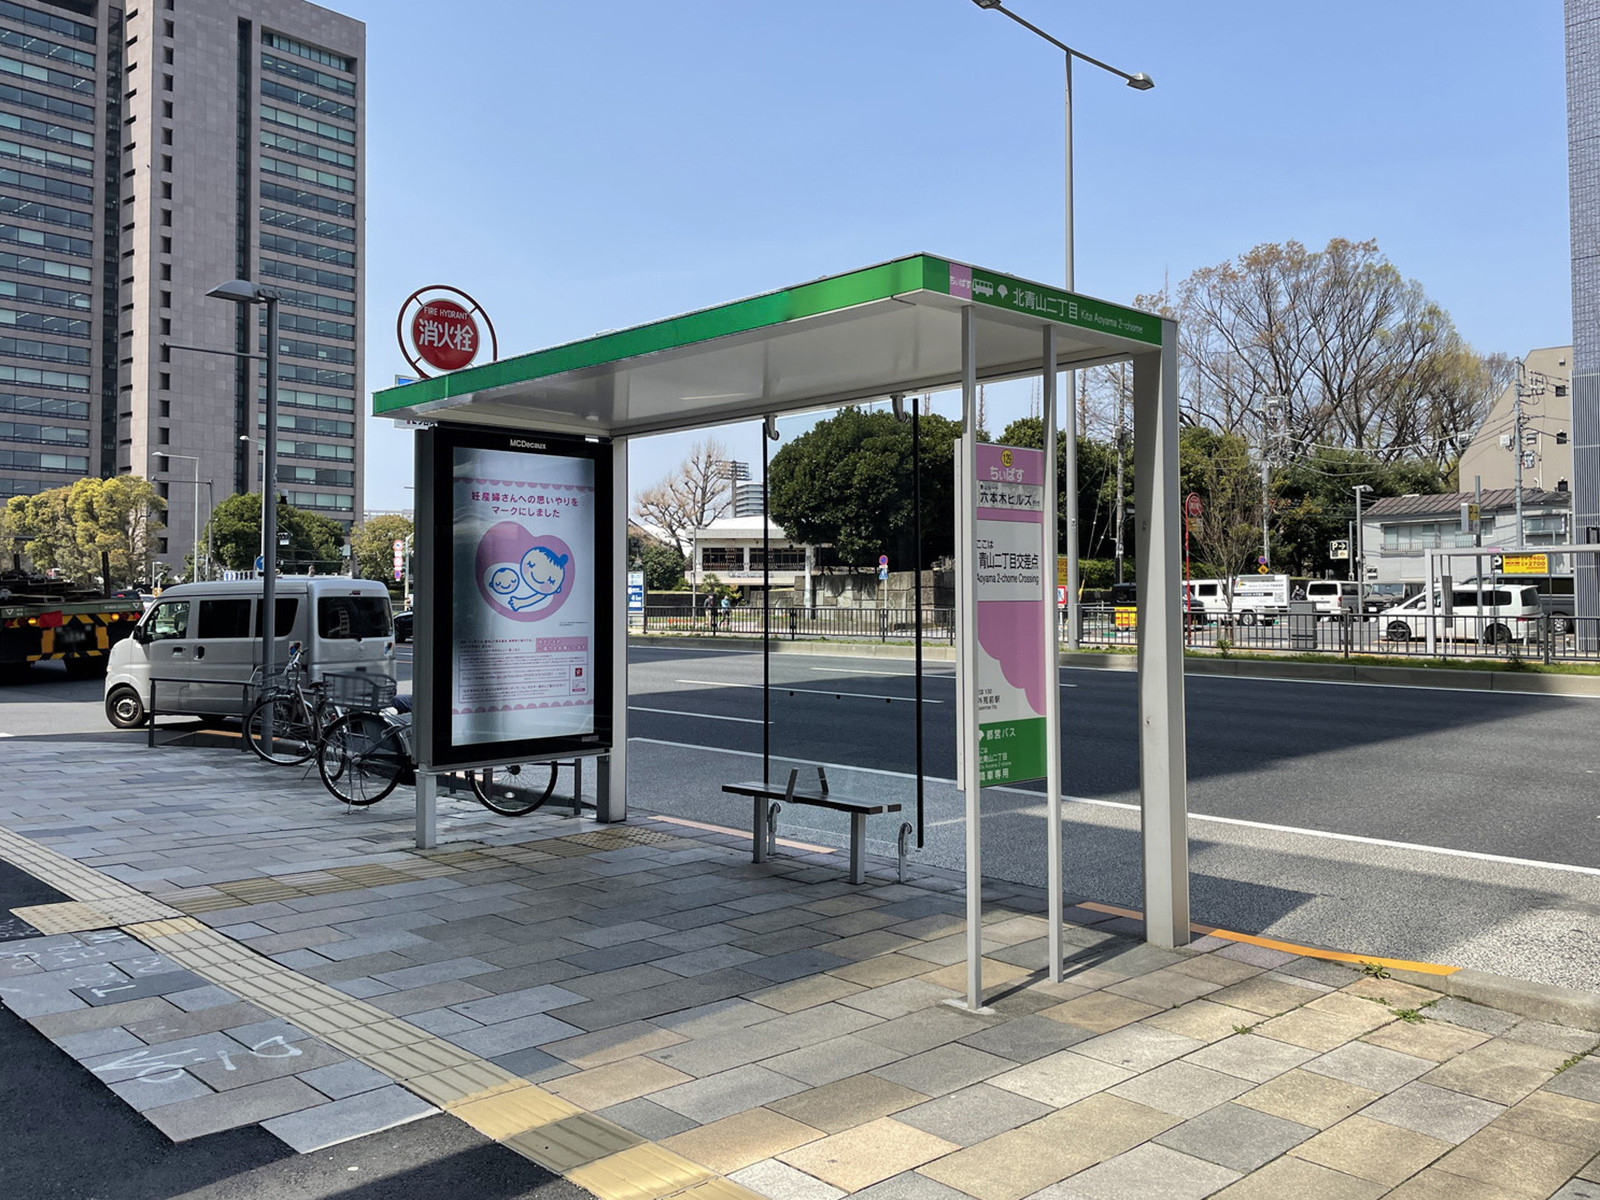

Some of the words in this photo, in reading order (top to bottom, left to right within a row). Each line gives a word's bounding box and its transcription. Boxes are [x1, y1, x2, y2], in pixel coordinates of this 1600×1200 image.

[423, 306, 438, 316] FIRE
[439, 309, 469, 320] HYDRANT
[1012, 287, 1078, 320] 北青山二丁目
[1094, 313, 1118, 328] Aoyama
[1118, 318, 1144, 335] 2-chome
[418, 318, 474, 352] 消火栓
[509, 438, 547, 450] MCDecaux
[471, 491, 579, 507] 妊産婦さんへの思いやりを
[491, 506, 561, 518] マークにしました
[978, 552, 1039, 570] 青山二丁目交差点
[997, 573, 1018, 583] 2-chome
[1018, 573, 1040, 586] Crossing
[986, 727, 1017, 741] 都営バス
